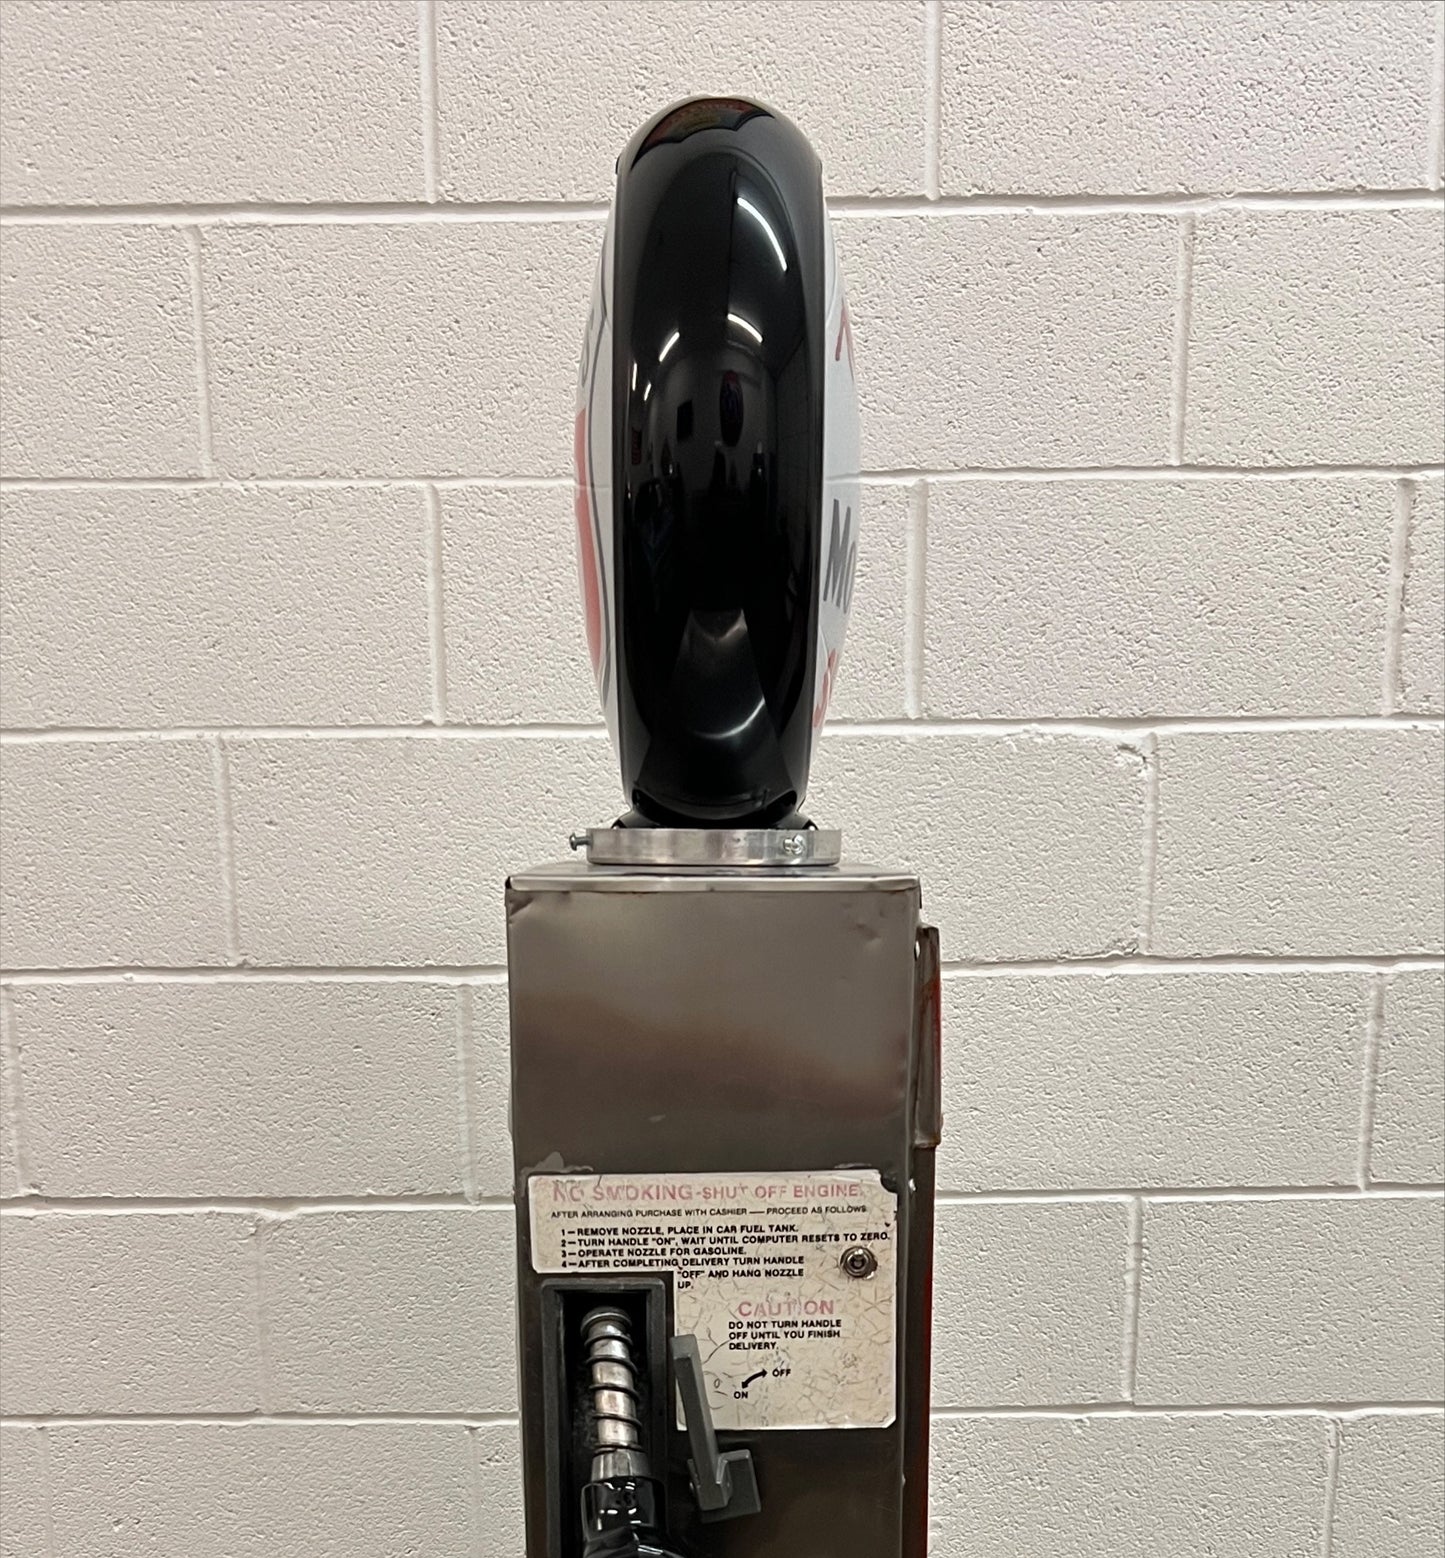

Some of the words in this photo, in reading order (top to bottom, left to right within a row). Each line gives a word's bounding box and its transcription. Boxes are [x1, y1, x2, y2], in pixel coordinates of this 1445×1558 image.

[551, 1209, 579, 1219] AFTER
[581, 1208, 633, 1218] ARRANGING
[635, 1207, 683, 1217] PURCHASE
[684, 1207, 707, 1216] WITH
[709, 1206, 748, 1216] CASHIER
[766, 1205, 809, 1215] PROCEED
[811, 1205, 823, 1214] AS
[667, 1225, 700, 1235] PLACE
[702, 1225, 713, 1235] IN
[716, 1225, 738, 1234] CAR
[740, 1224, 766, 1234] FUEL
[768, 1223, 799, 1233] TANK.
[608, 1237, 650, 1247] HANDLE
[680, 1236, 706, 1245] WAIT
[709, 1236, 739, 1245] UNTIL
[741, 1234, 799, 1244] COMPUTER
[801, 1233, 841, 1243] RESETS
[843, 1232, 858, 1242] TO
[860, 1231, 891, 1241] ZERO.
[627, 1247, 667, 1257] NOZZLE
[669, 1247, 691, 1256] FOR
[693, 1246, 747, 1256] GASOLINE.
[613, 1258, 679, 1268] COMPLETING
[682, 1257, 730, 1267] DELIVERY
[732, 1256, 761, 1266] TURN
[763, 1255, 805, 1265] HANDLE
[708, 1269, 730, 1278] AND
[732, 1268, 762, 1278] HANG
[764, 1267, 805, 1277] NOZZLE
[677, 1280, 694, 1290] UP.
[728, 1320, 744, 1330] DO
[746, 1320, 768, 1330] NOT
[771, 1319, 799, 1329] TURN
[801, 1318, 843, 1328] HANDLE
[728, 1331, 748, 1341] OFF
[750, 1330, 781, 1340] UNTIL
[783, 1330, 805, 1339] YOU
[807, 1329, 841, 1339] FINISH
[771, 1367, 792, 1378] OFF
[733, 1390, 749, 1400] ON
